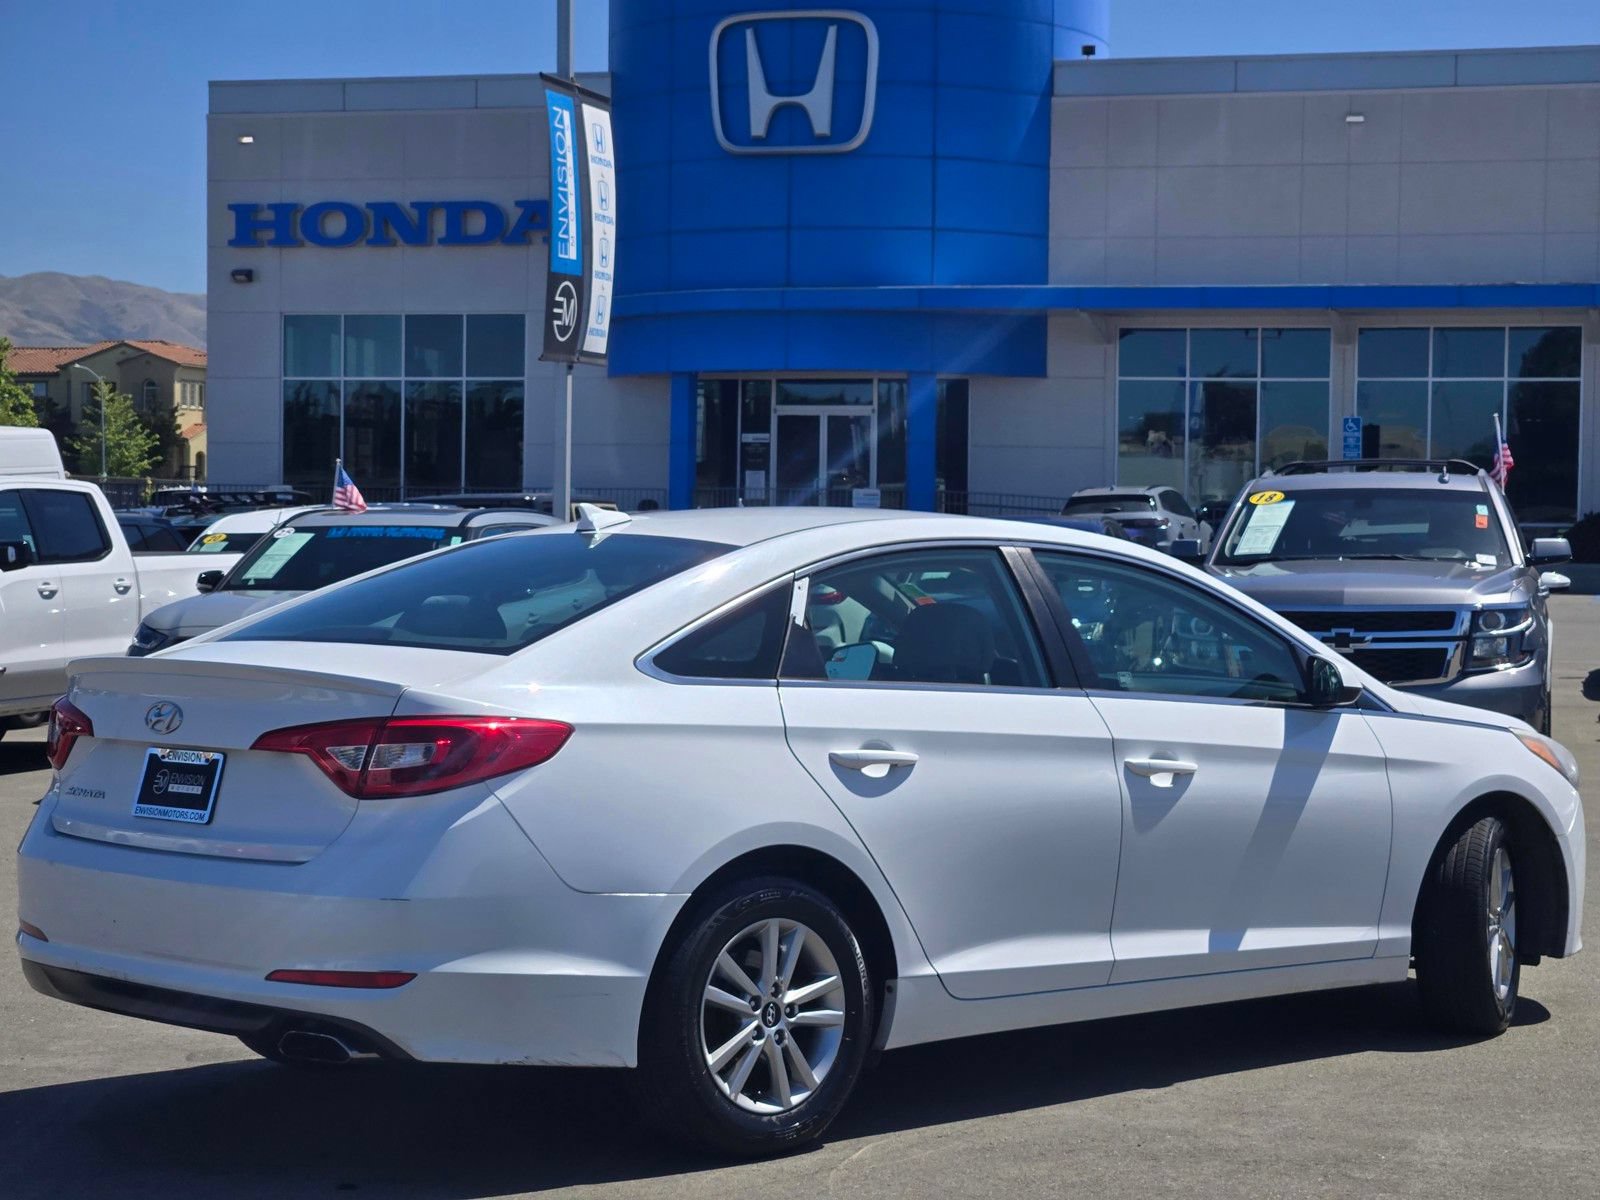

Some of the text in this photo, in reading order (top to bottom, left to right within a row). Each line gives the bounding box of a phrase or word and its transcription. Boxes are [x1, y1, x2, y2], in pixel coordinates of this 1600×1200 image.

[552, 106, 570, 258] ENVISION
[227, 200, 550, 248] HONDA
[1255, 493, 1278, 503] 18
[167, 752, 202, 763] ENVISION
[169, 773, 206, 785] ENVISION
[134, 806, 207, 821] ENVISIONMOTORS.COM
